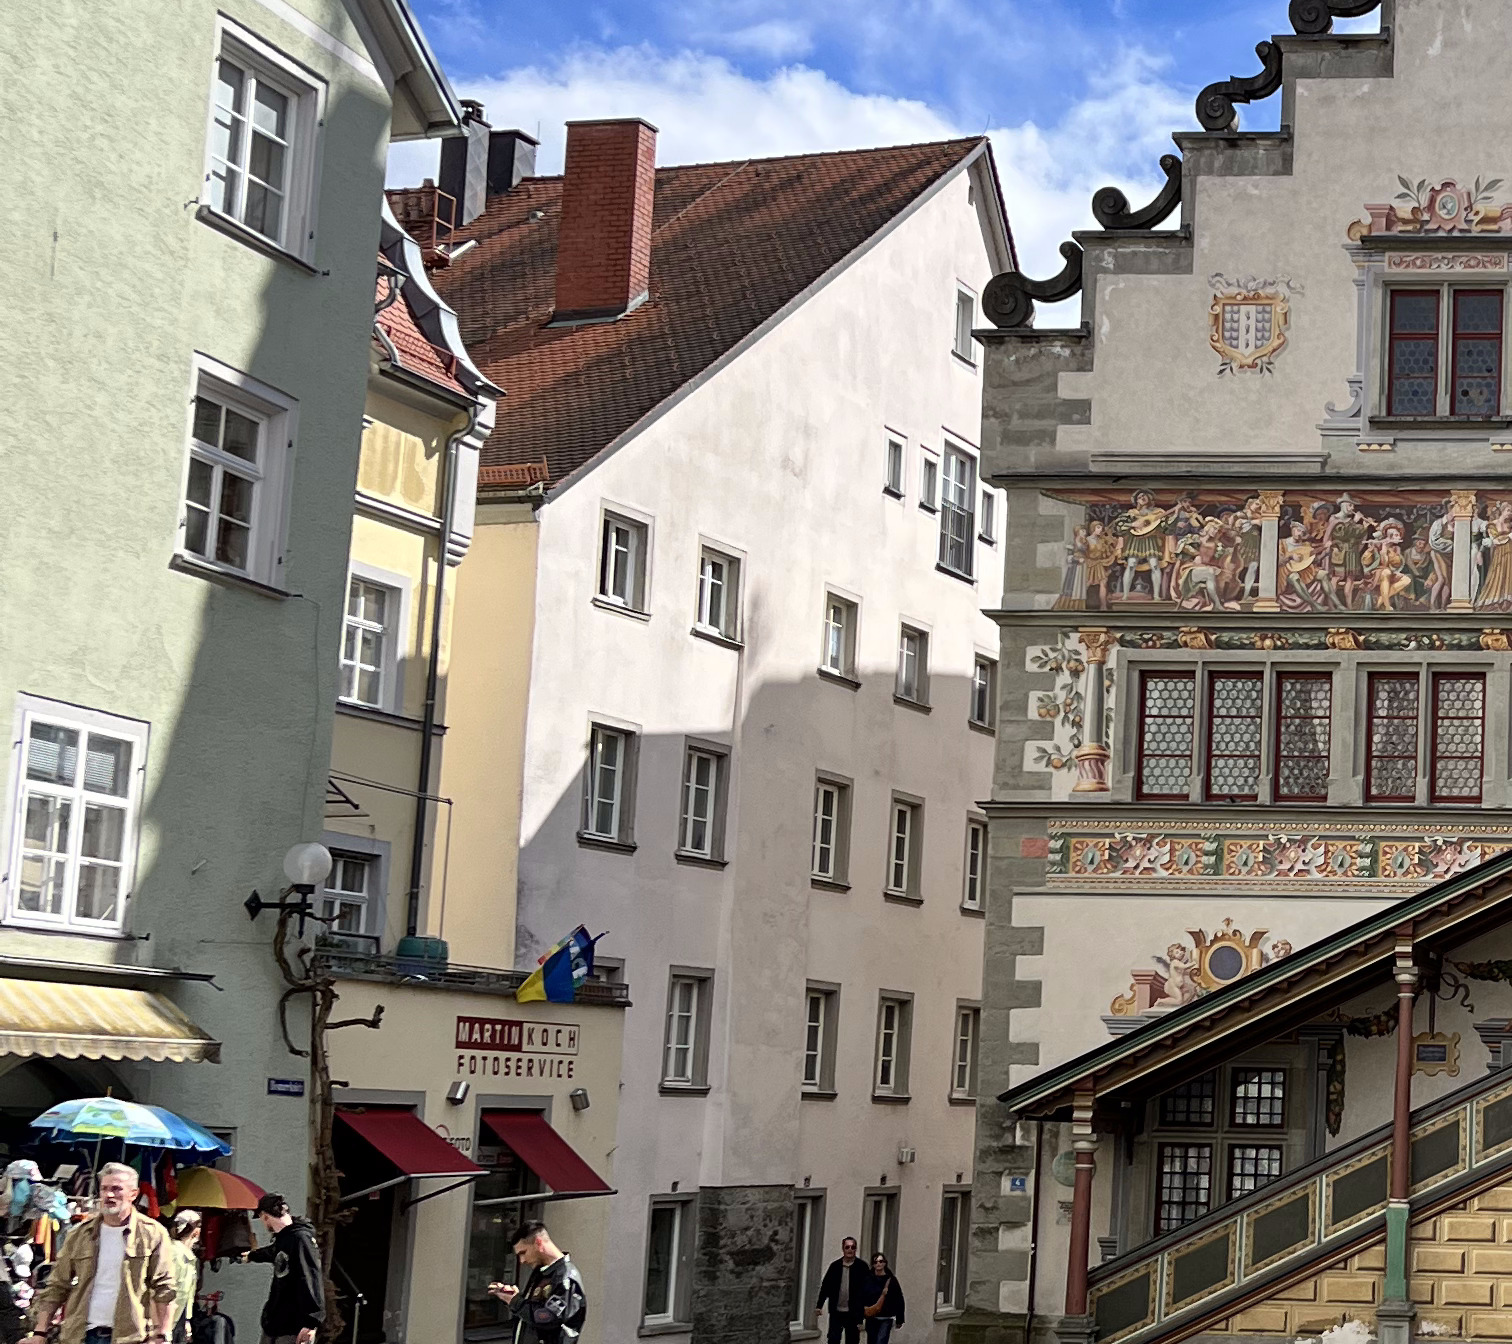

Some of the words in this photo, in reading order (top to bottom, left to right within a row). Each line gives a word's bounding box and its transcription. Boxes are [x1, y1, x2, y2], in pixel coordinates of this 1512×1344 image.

[458, 1021, 520, 1045] MARTIN
[527, 1027, 577, 1048] KOCH
[457, 1055, 575, 1078] FOTOSERVICE
